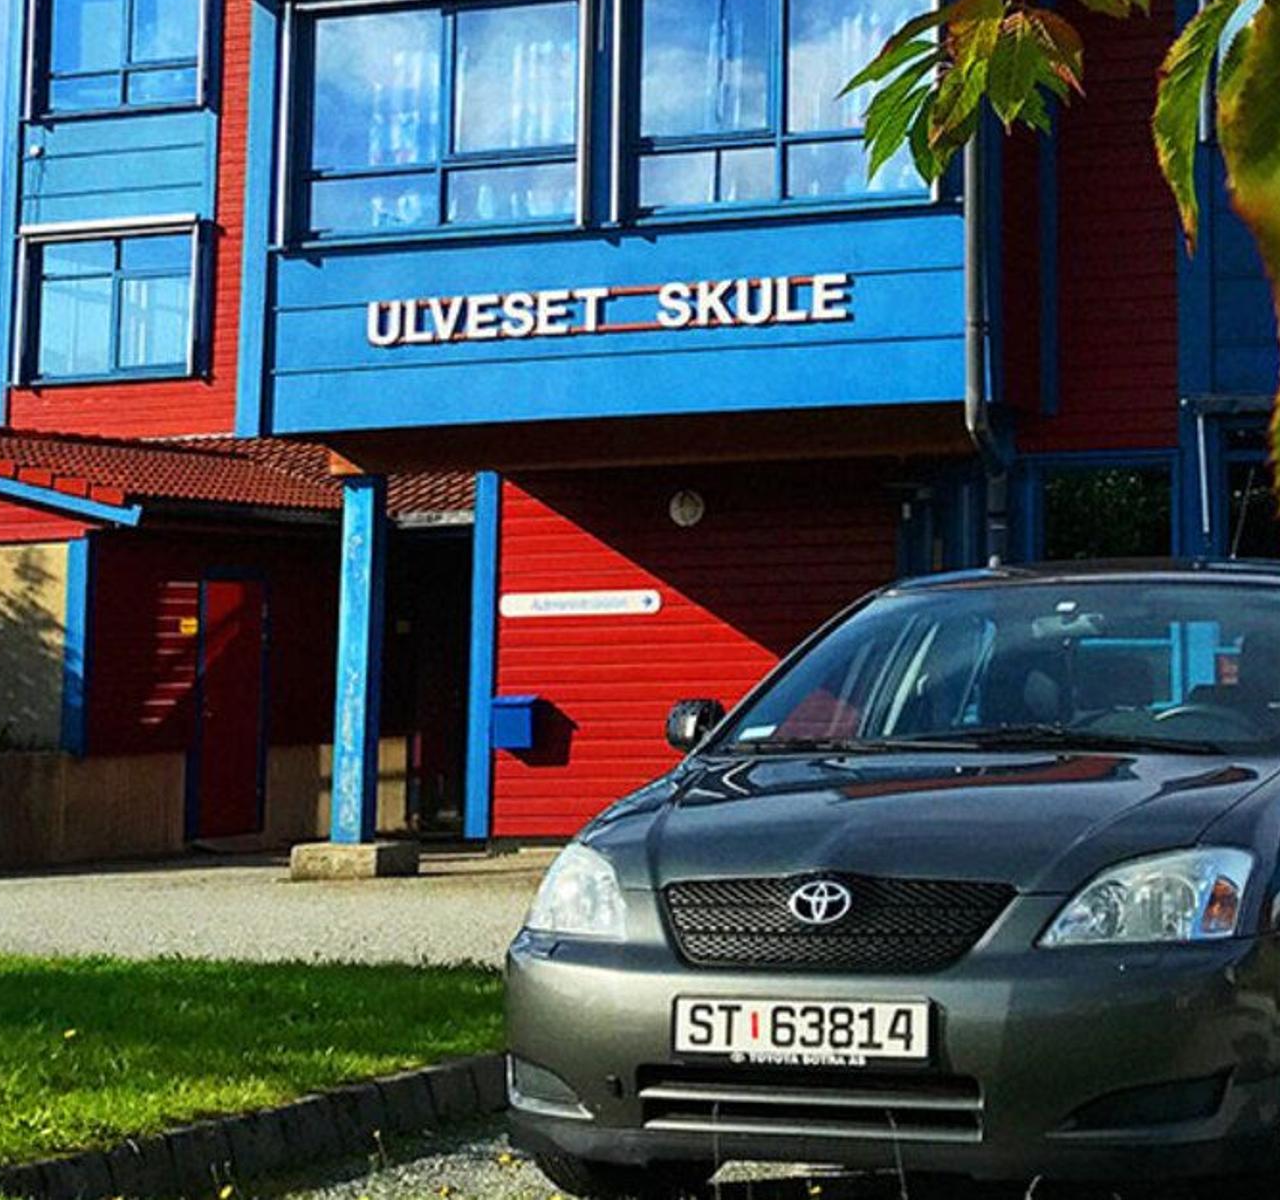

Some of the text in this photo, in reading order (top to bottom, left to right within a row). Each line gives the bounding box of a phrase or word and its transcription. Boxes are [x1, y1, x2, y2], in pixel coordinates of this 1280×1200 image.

[367, 273, 847, 345] ULVESET SKULE
[688, 1004, 913, 1051] ST 63814
